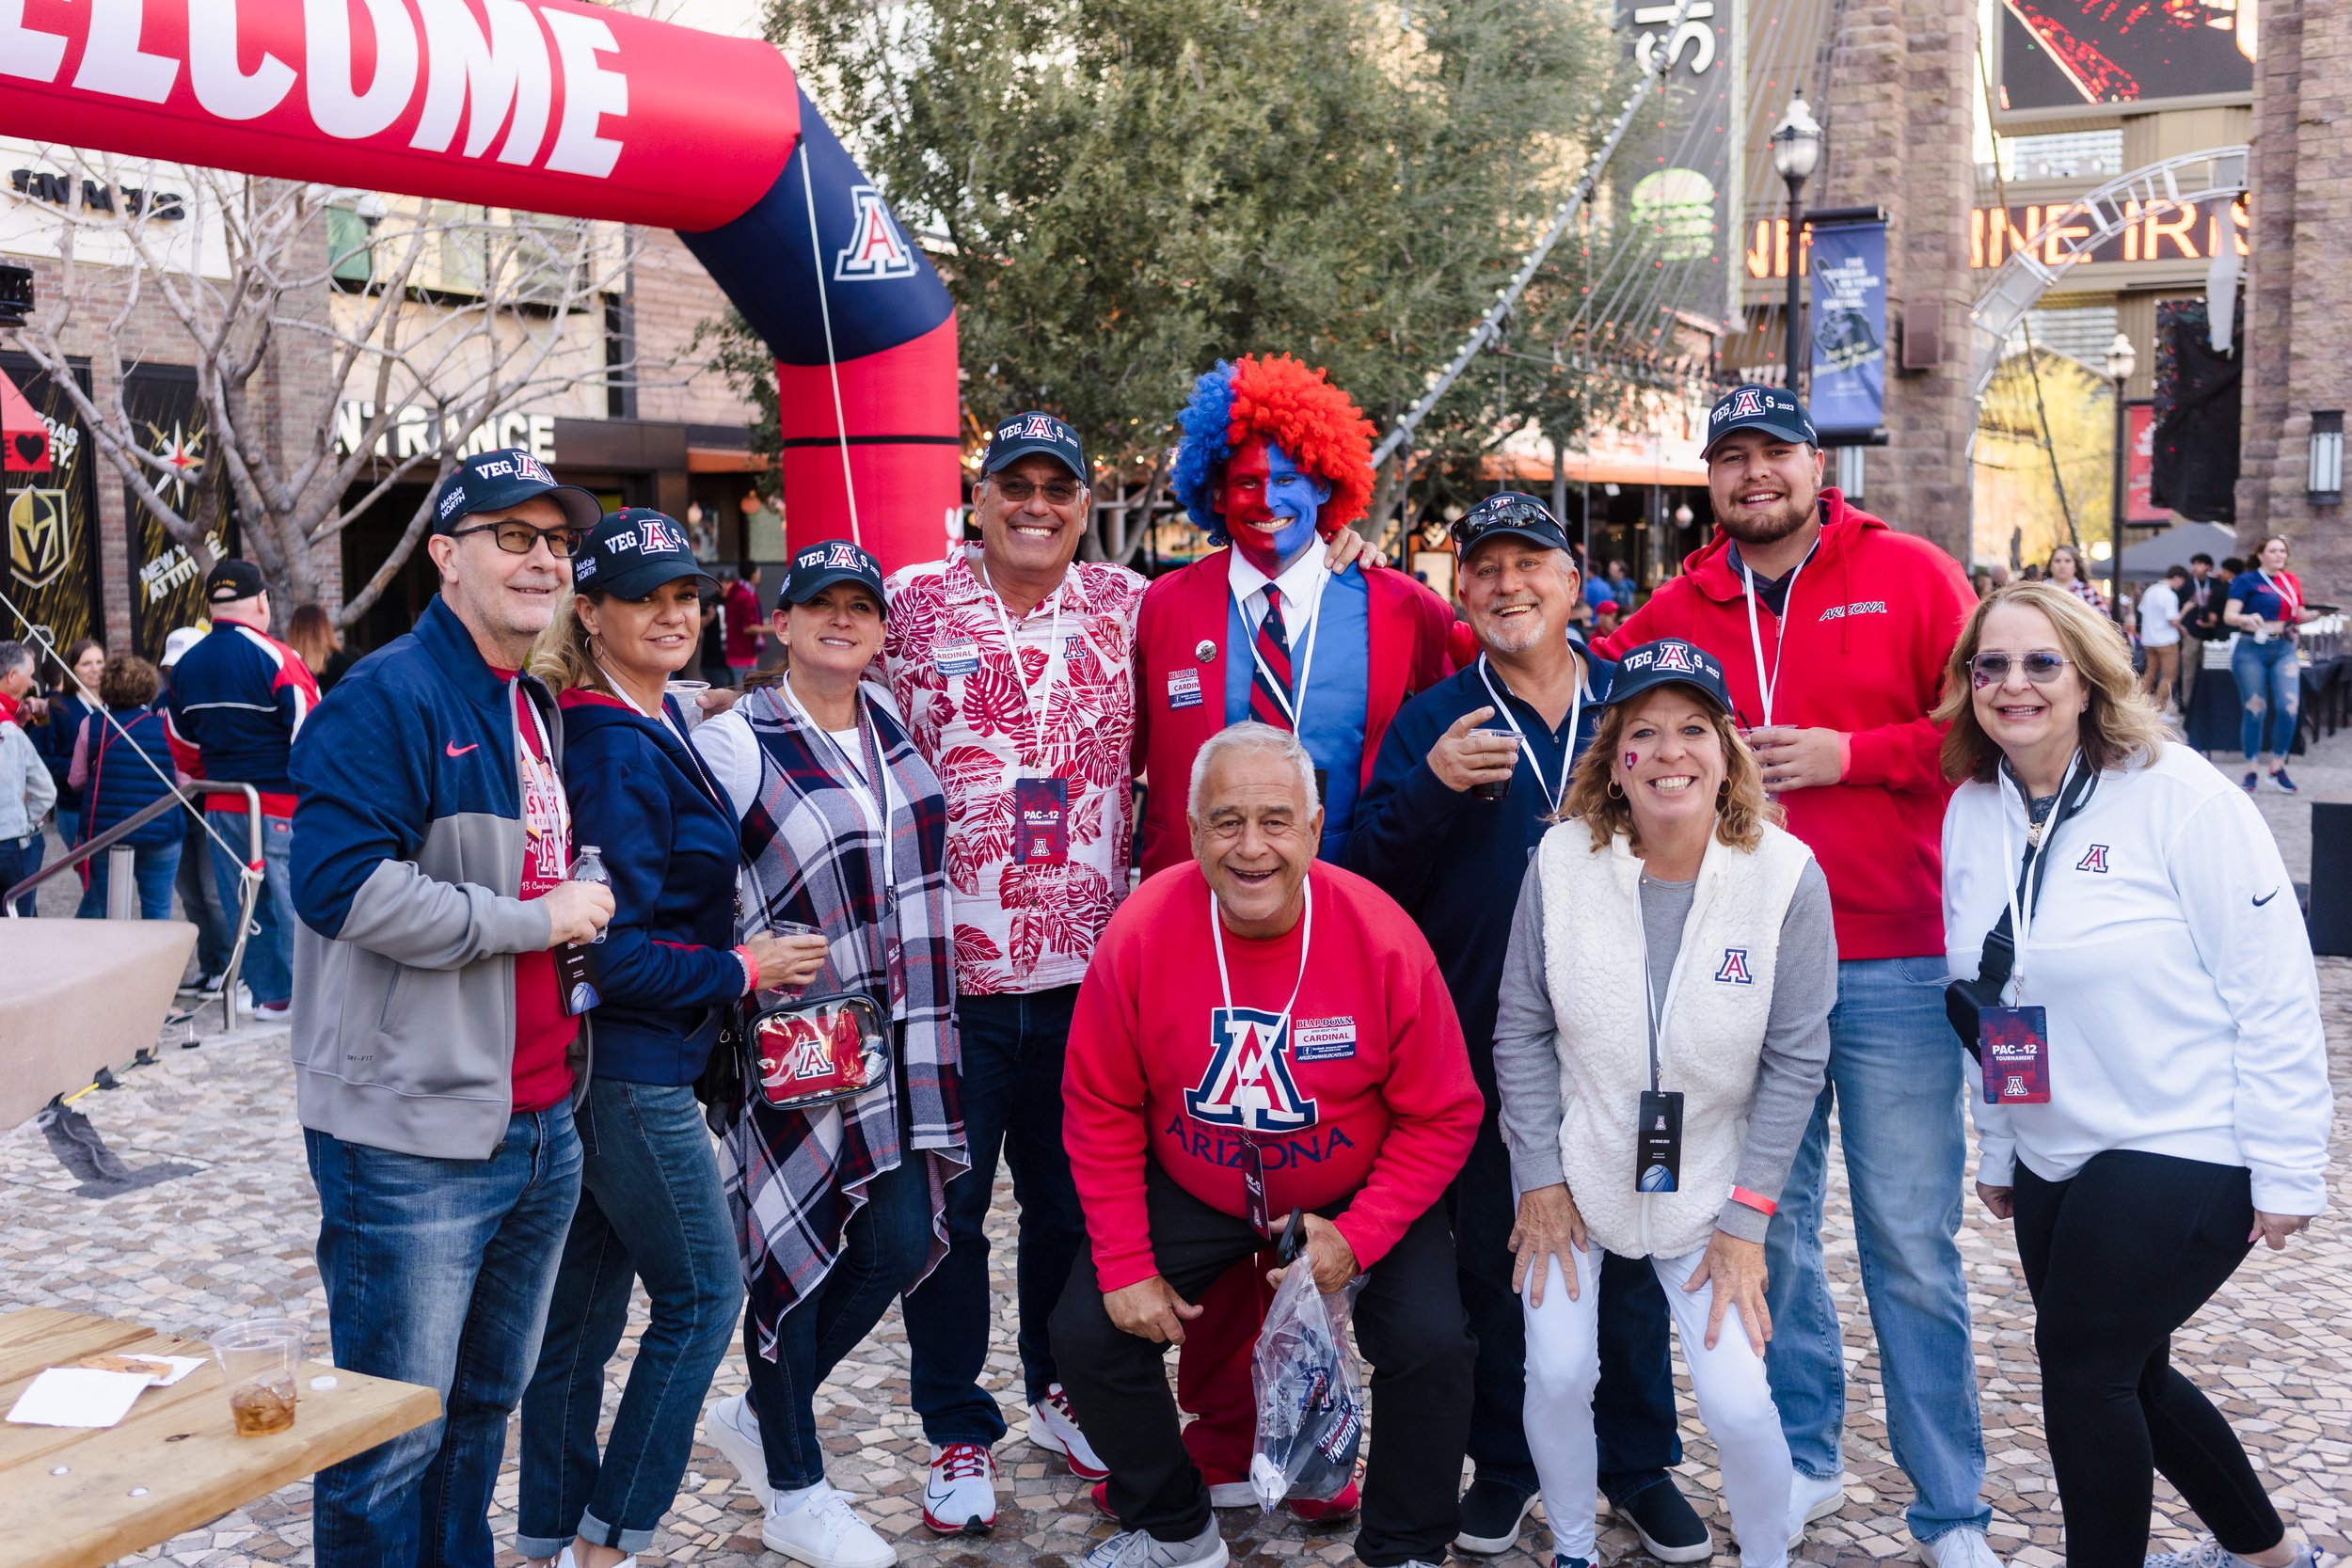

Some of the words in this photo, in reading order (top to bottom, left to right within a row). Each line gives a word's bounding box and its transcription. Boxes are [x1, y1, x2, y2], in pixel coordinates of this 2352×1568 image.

[1777, 403, 1794, 412] 2023
[439, 485, 464, 511] McKale
[440, 493, 466, 519] NORTH
[577, 566, 596, 581] NORTH
[1706, 664, 1720, 679] 2023
[1303, 1032, 1350, 1042] CARDINAL
[1992, 1045, 2038, 1054] PAC-12
[1166, 1114, 1356, 1171] ARIZONA
